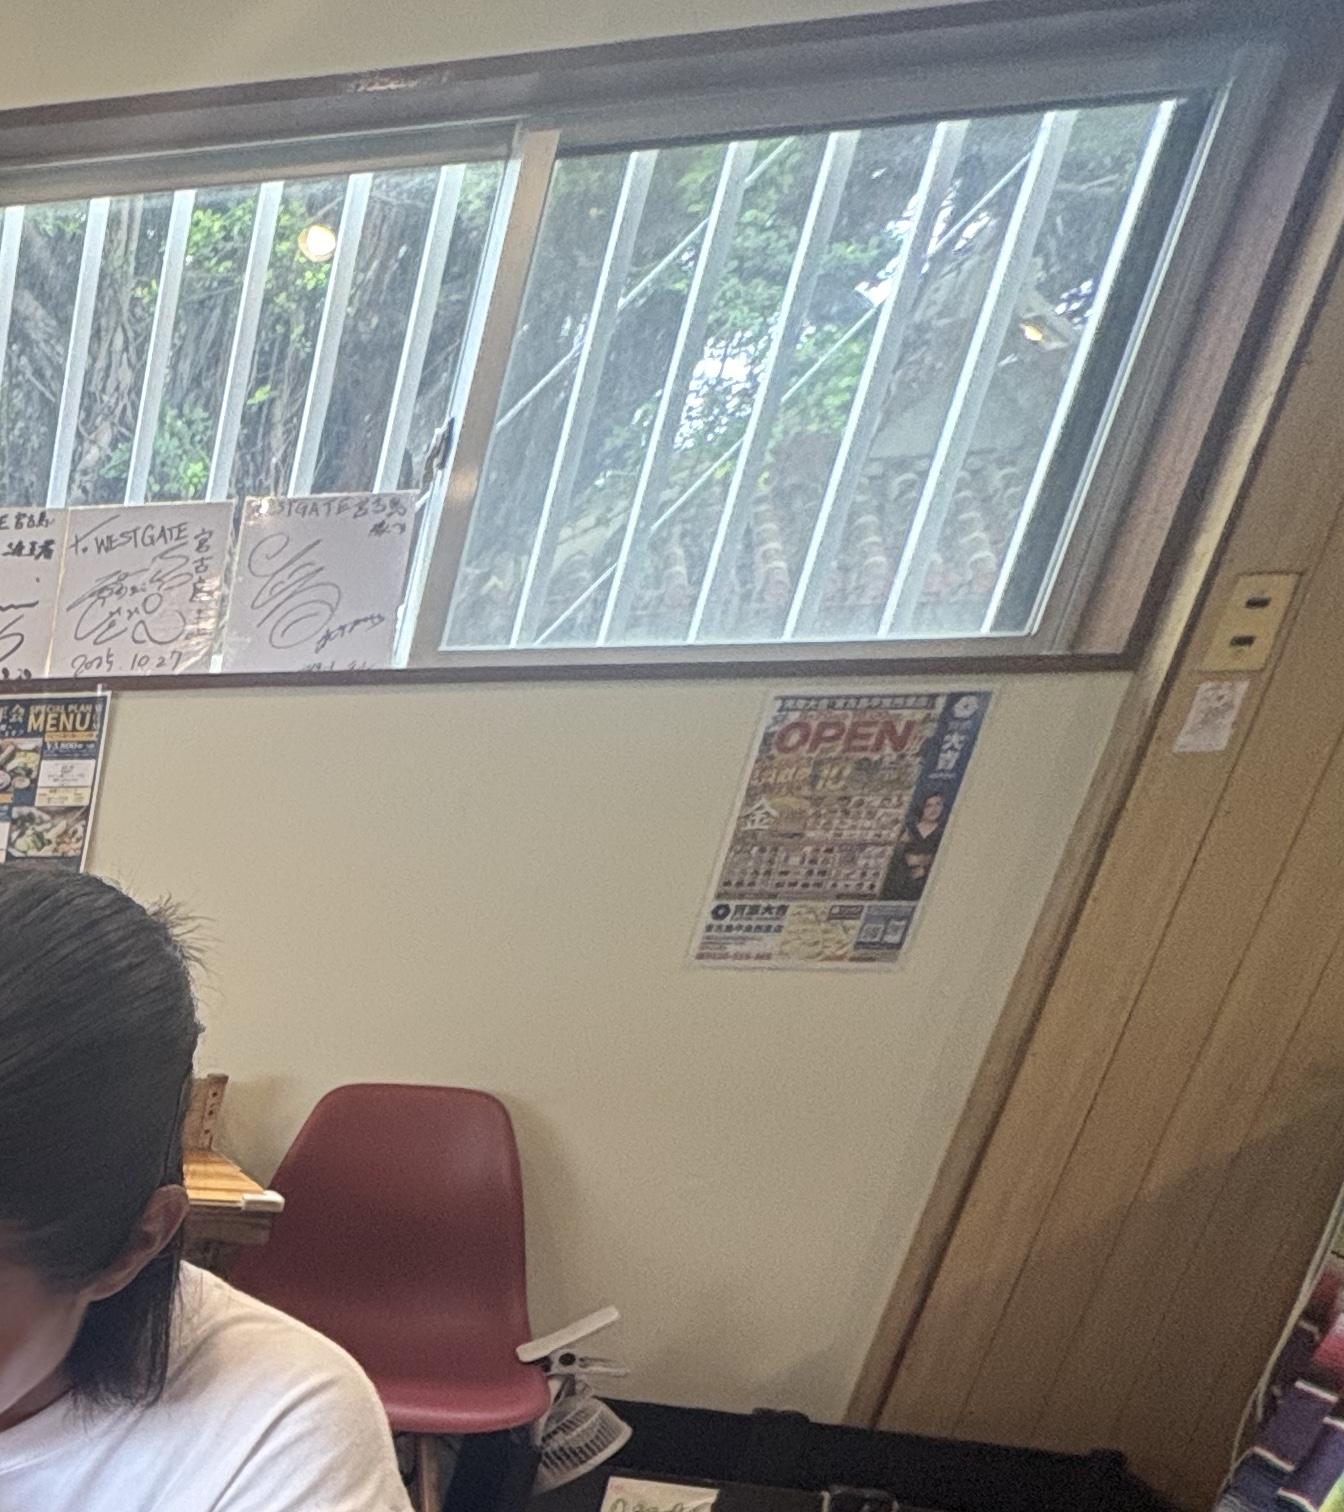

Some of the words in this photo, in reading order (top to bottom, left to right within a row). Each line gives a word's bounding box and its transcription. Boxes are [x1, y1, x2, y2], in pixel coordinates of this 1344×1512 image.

[95, 521, 188, 554] WESTGATE
[26, 712, 92, 733] MENU
[774, 719, 918, 754] OPEN
[740, 795, 781, 832] 金
